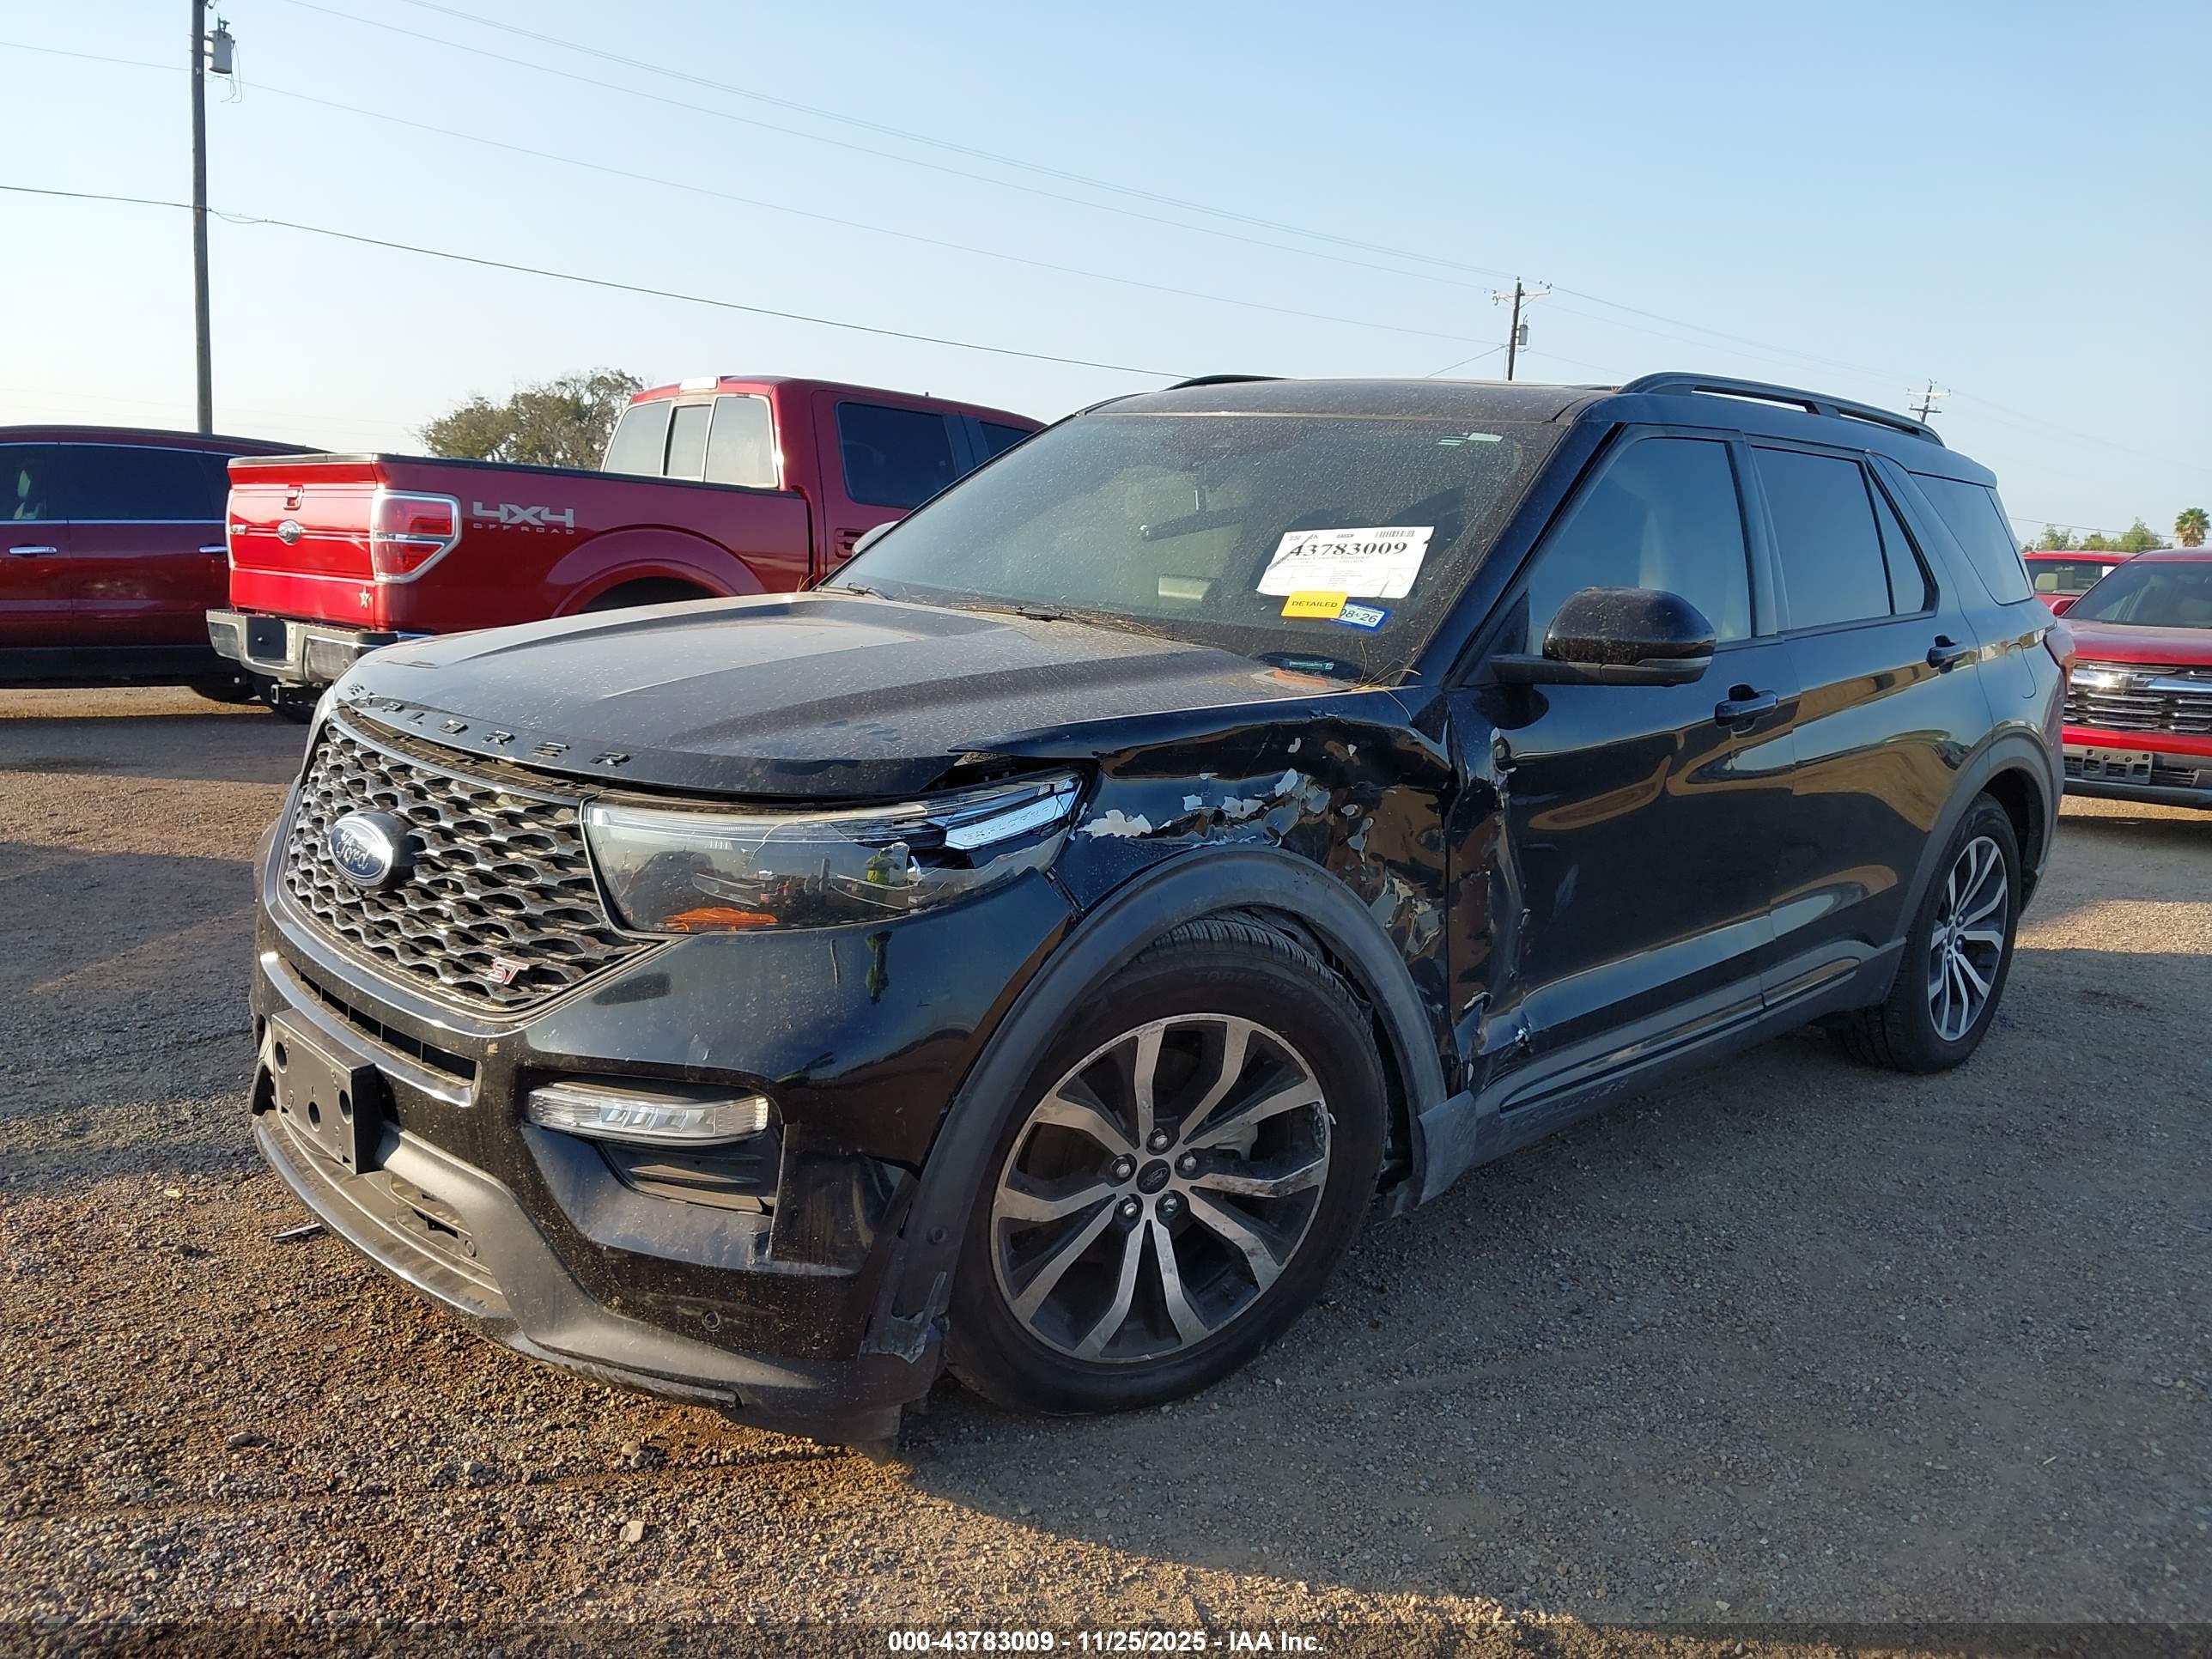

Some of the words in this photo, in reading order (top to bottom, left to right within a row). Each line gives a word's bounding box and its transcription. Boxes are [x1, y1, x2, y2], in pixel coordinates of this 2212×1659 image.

[473, 501, 574, 528] 4X4
[520, 526, 574, 535] ROAD
[1290, 542, 1407, 556] 43783009
[348, 682, 631, 768] EXPLORER
[336, 828, 369, 871] Ford
[485, 956, 530, 985] ST
